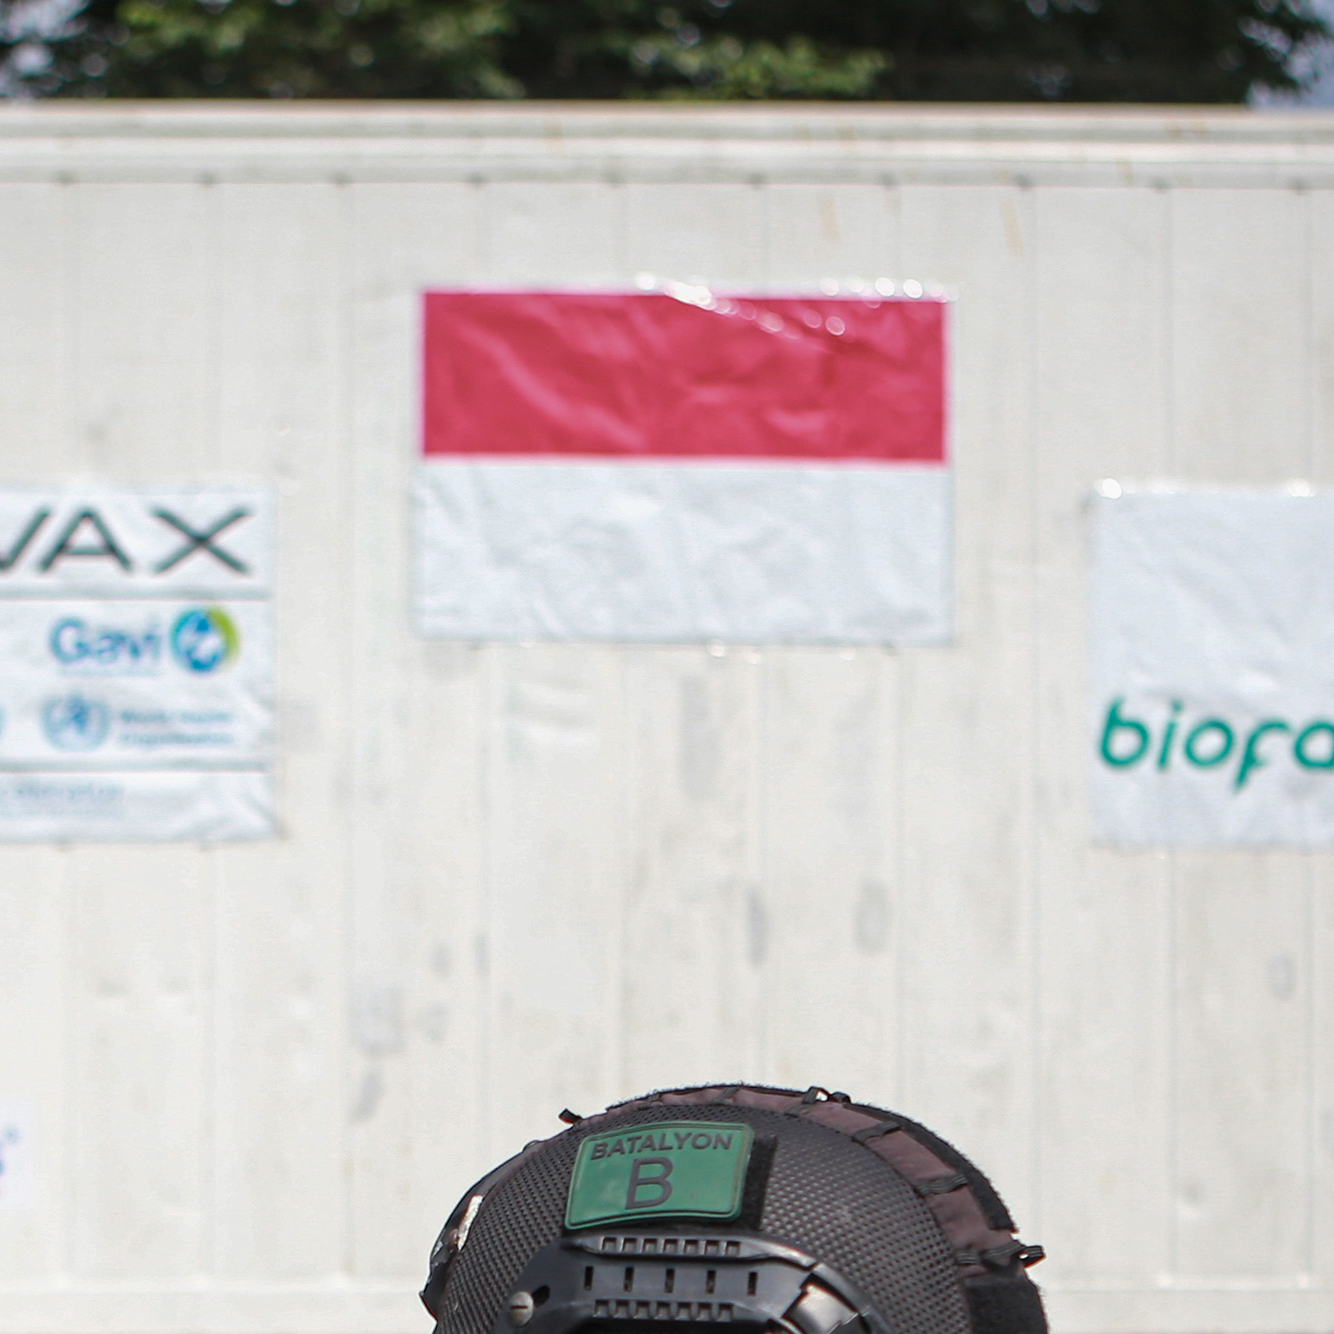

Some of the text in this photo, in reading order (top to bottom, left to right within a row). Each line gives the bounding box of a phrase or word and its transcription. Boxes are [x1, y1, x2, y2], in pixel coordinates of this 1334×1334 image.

[48, 614, 163, 666] Gavi
[590, 1131, 734, 1161] BATALYON
[624, 1156, 674, 1210] B
